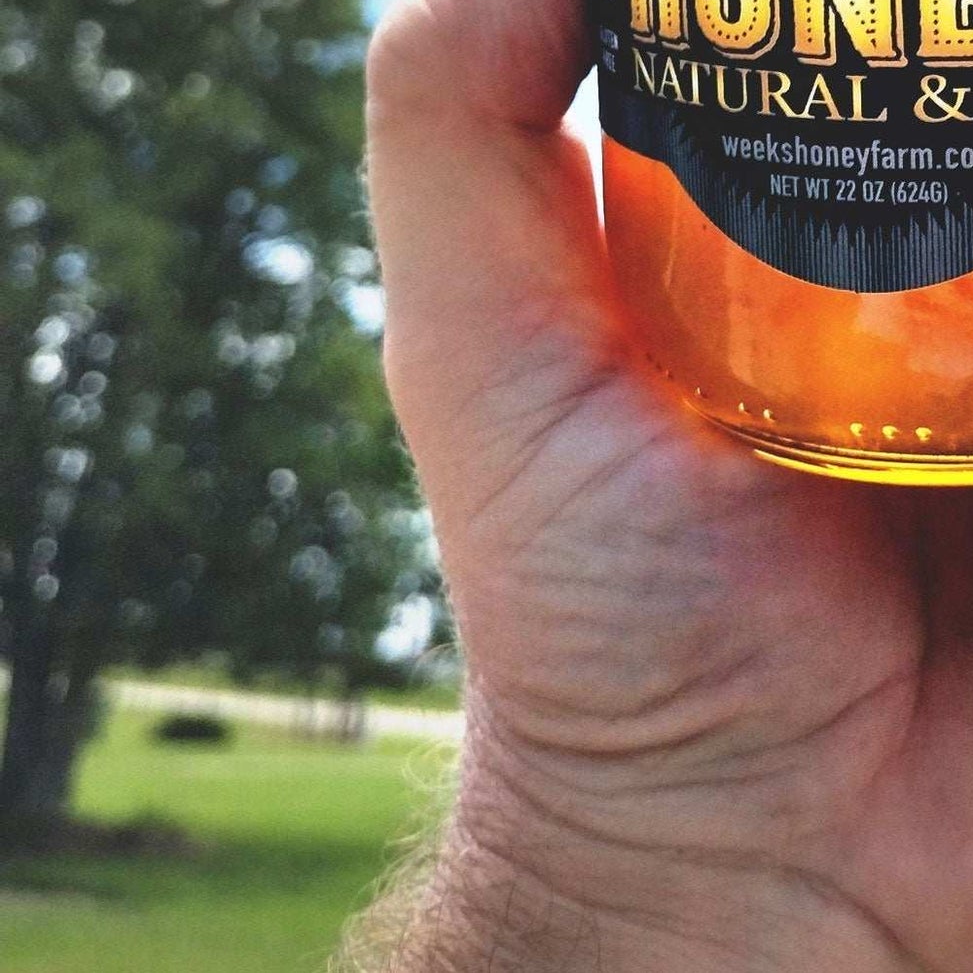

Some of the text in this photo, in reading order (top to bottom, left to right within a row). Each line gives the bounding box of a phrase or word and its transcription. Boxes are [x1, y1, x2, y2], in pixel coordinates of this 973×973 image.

[633, 48, 888, 123] NATURAL
[770, 174, 949, 205] NET WT 22 OZ (624G)
